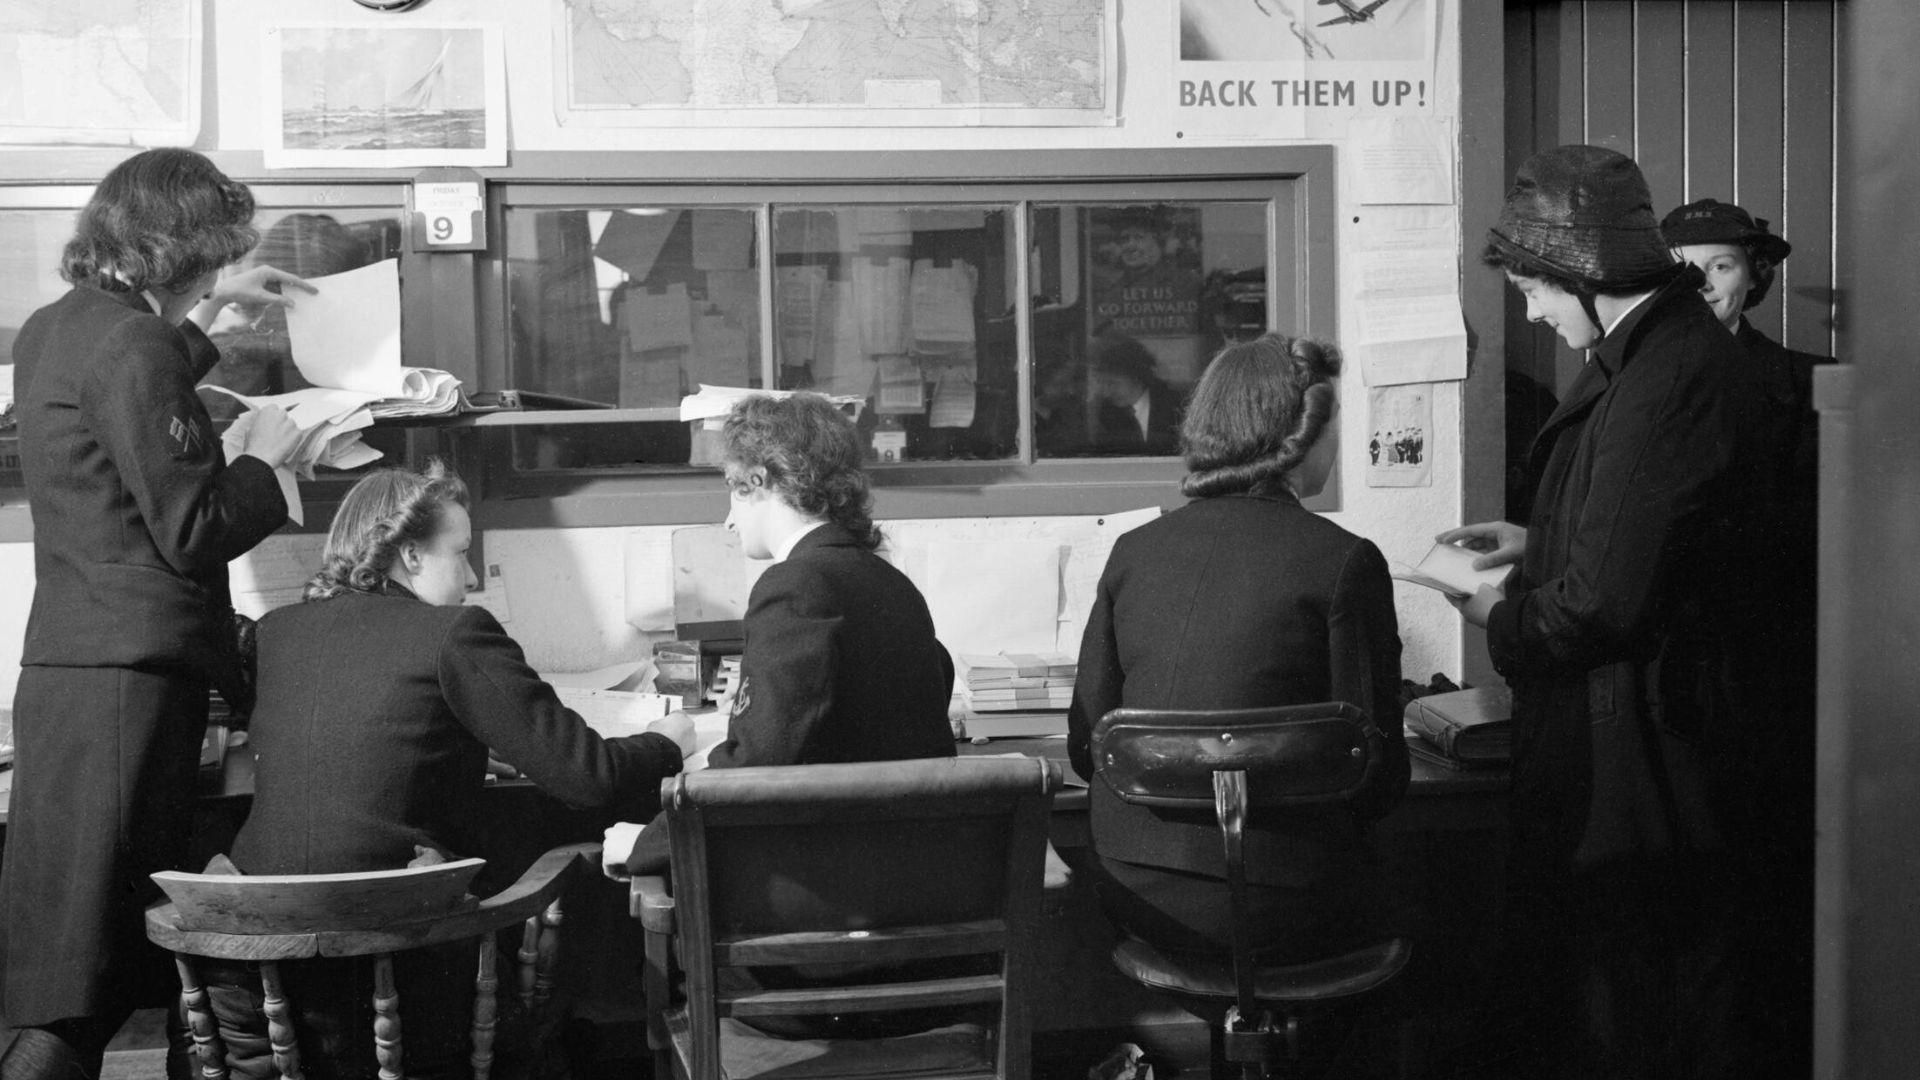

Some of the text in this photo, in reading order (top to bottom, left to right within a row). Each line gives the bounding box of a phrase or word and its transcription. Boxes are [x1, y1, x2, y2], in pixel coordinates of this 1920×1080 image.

[1179, 80, 1426, 107] BACK THEM UP!
[433, 216, 454, 240] 9
[1123, 286, 1174, 301] LET US
[1097, 299, 1199, 316] GO FORWARD
